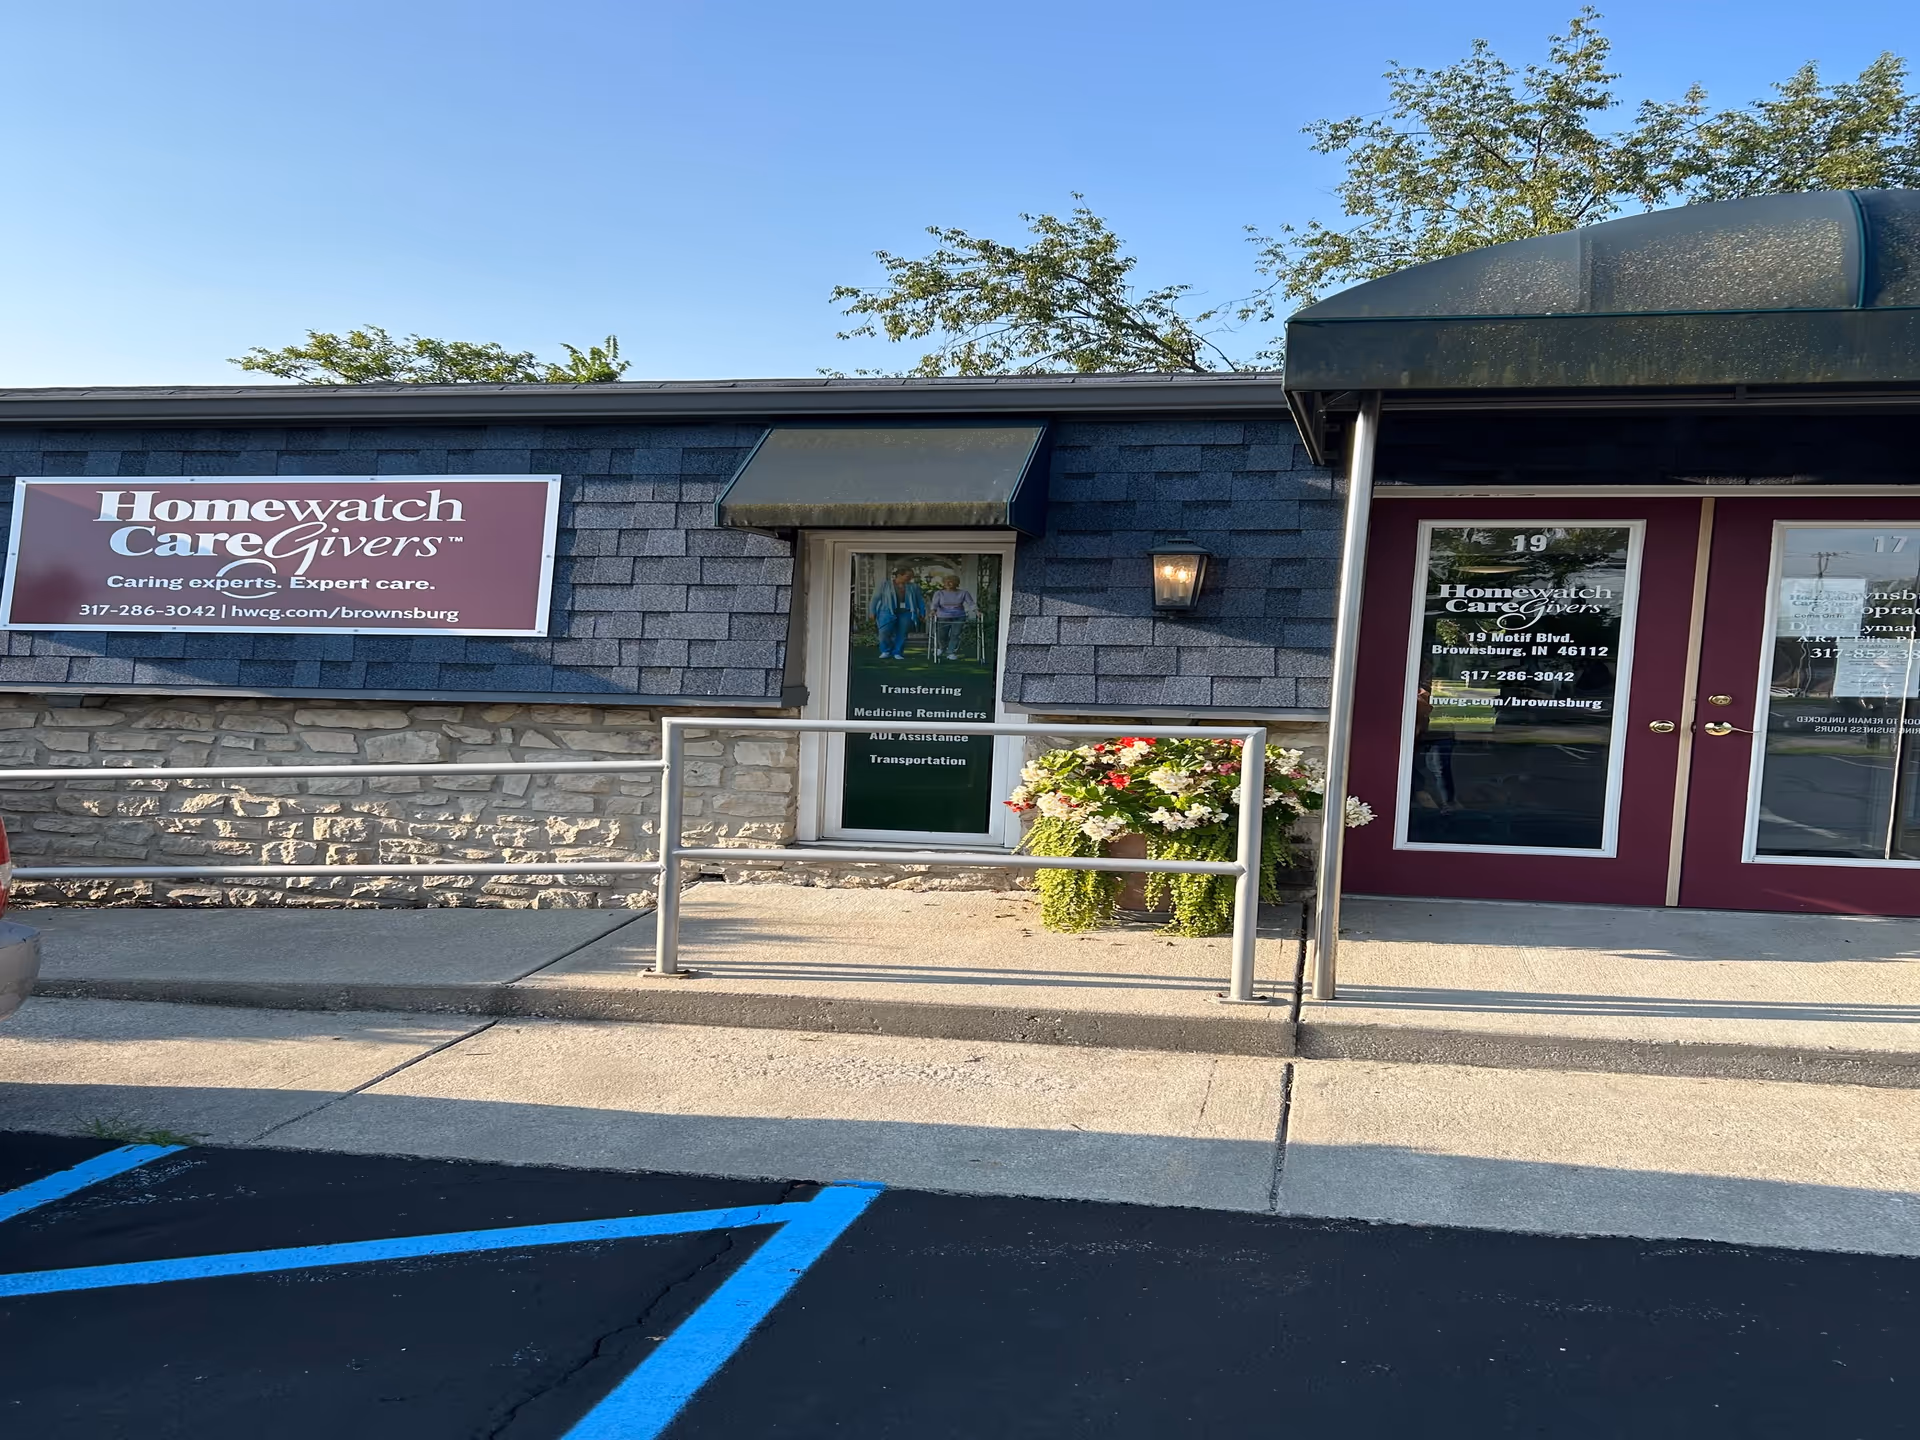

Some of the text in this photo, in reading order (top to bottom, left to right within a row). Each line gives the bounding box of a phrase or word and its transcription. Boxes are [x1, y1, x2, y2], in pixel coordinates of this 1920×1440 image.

[92, 488, 467, 522] Homewatch
[109, 521, 443, 576] CareGivers
[1509, 534, 1547, 552] 19
[1872, 535, 1908, 553] 17
[106, 575, 436, 591] Caring experts. Expert care.
[1438, 584, 1612, 599] Homewatch
[79, 604, 216, 617] 317-286-3042
[231, 605, 460, 623] hwcg.com/brownsburg
[1445, 597, 1604, 630] CareGivers
[1852, 623, 1917, 634] Lyman
[1468, 632, 1575, 643] 19 Motif Blvd.
[1432, 645, 1609, 657] Brownsburg, IN 46112
[1810, 648, 1920, 659] 317-852-38
[1460, 670, 1575, 682] 317-286-3042
[880, 684, 963, 697] Transferring
[1429, 696, 1602, 709] hwcg.com/brownsburg
[854, 707, 987, 719] Medicine Reminders
[869, 732, 969, 742] ADL Assistance
[869, 754, 967, 766] Transportation
